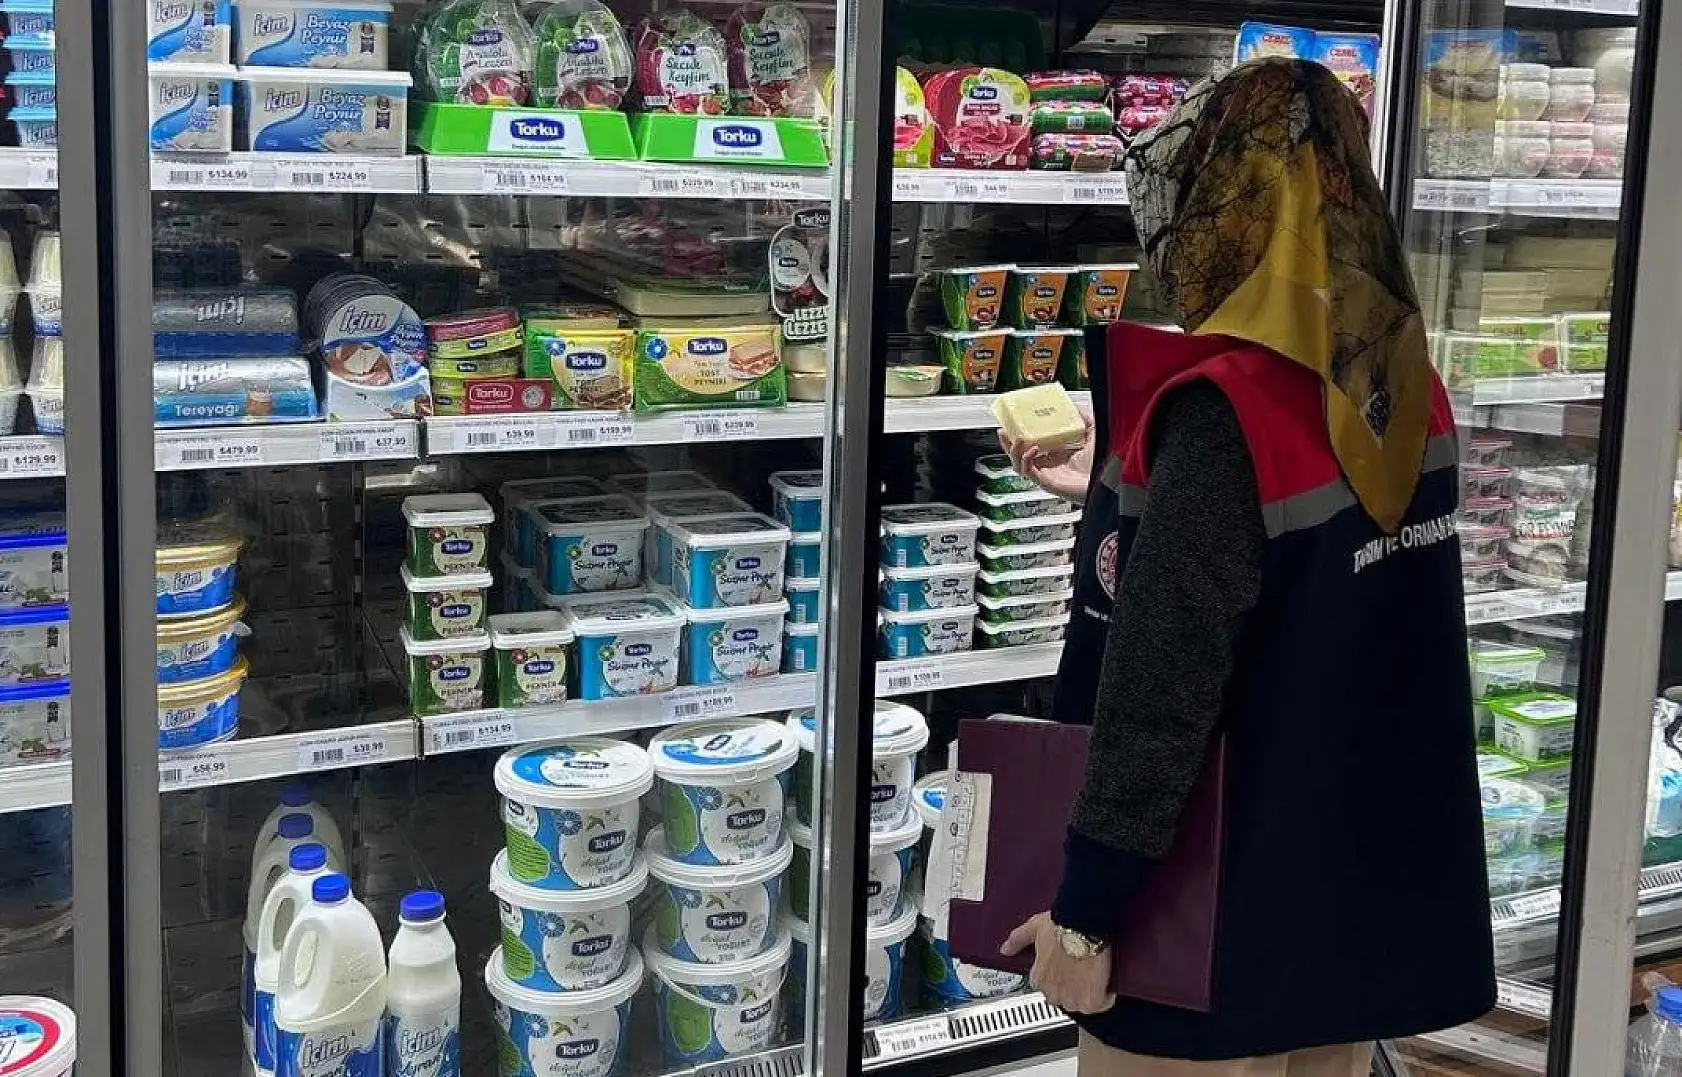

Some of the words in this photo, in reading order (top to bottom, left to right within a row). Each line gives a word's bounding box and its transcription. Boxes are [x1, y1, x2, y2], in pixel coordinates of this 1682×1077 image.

[307, 14, 351, 31] Beyaz
[302, 29, 347, 45] Peynir
[320, 88, 366, 105] Beyaz
[314, 104, 360, 119] Peynir
[515, 122, 558, 135] Torku
[718, 129, 757, 142] Torku
[475, 389, 507, 399] Torku
[595, 833, 622, 849] Torku
[710, 916, 744, 928] Torku
[577, 939, 610, 953] Torku
[560, 1043, 595, 1057] Torku
